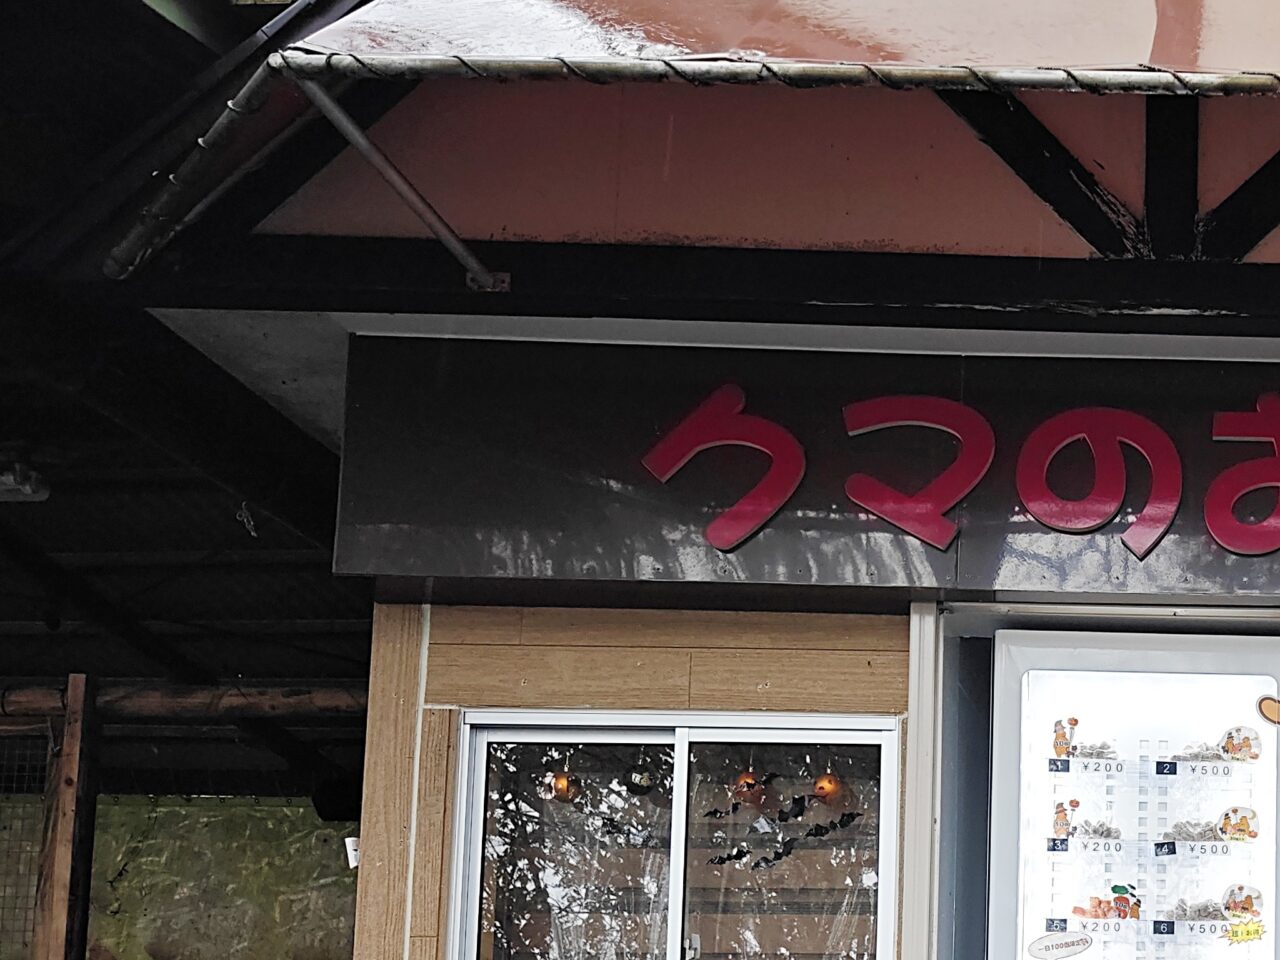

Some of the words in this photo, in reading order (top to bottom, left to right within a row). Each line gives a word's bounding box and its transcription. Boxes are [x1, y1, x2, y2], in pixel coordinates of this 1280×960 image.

[1082, 762, 1123, 772] ¥200
[1164, 764, 1170, 773] 2
[1190, 765, 1230, 775] ¥500
[1054, 840, 1061, 849] 3
[1082, 842, 1121, 851] ¥200
[1162, 844, 1168, 853] 4
[1189, 845, 1228, 855] ¥500
[1081, 923, 1120, 932] ¥200
[1161, 924, 1168, 932] 6
[1188, 924, 1228, 934] ¥500
